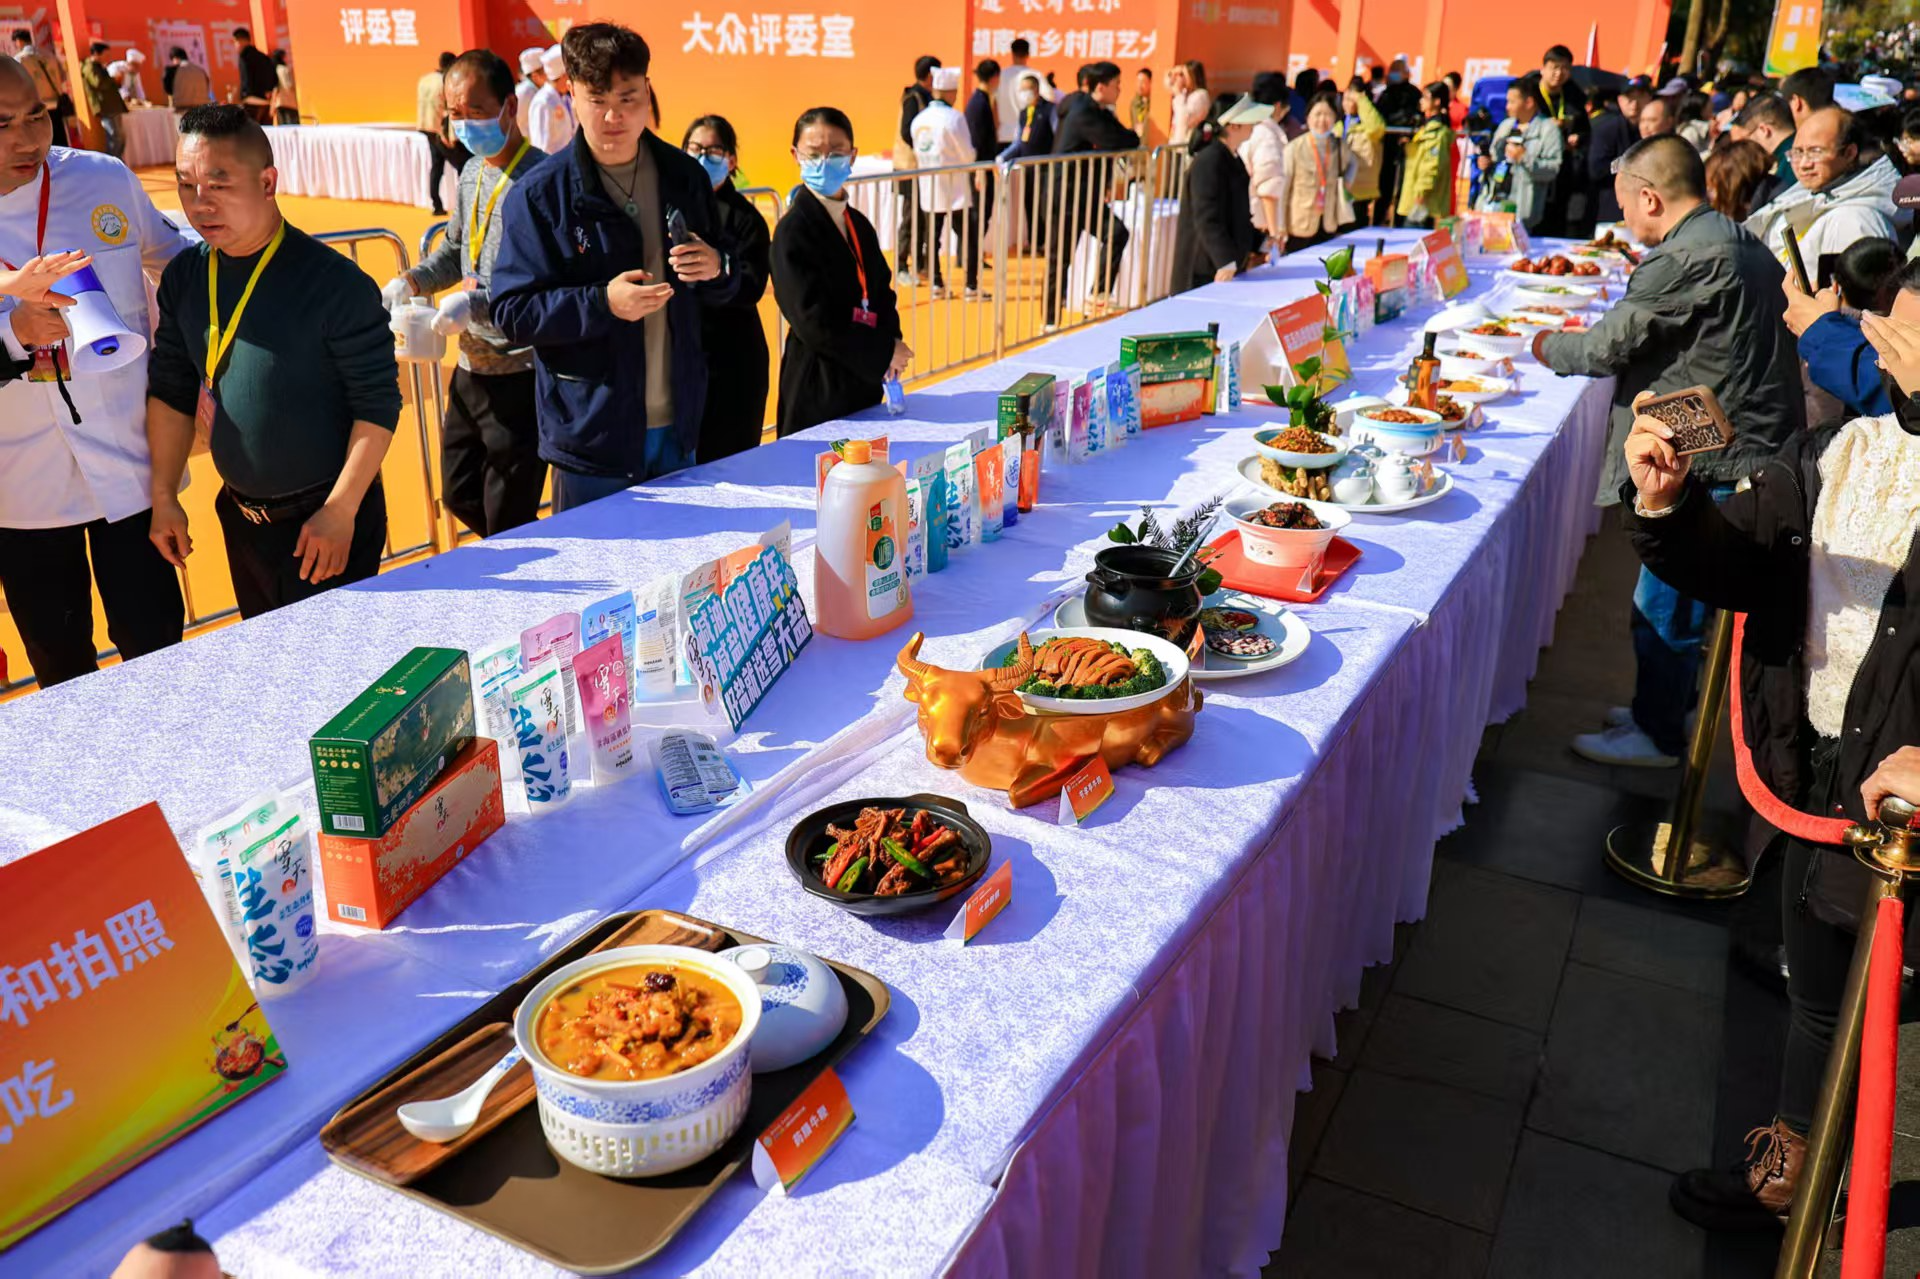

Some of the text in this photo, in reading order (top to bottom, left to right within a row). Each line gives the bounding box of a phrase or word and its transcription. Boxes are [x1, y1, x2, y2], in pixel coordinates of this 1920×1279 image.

[340, 8, 418, 46] 评委室
[681, 11, 855, 58] 大众评委室
[724, 594, 812, 728] 好盐就选雪天盐
[0, 899, 176, 1027] 和拍照
[0, 1058, 76, 1145] 吃
